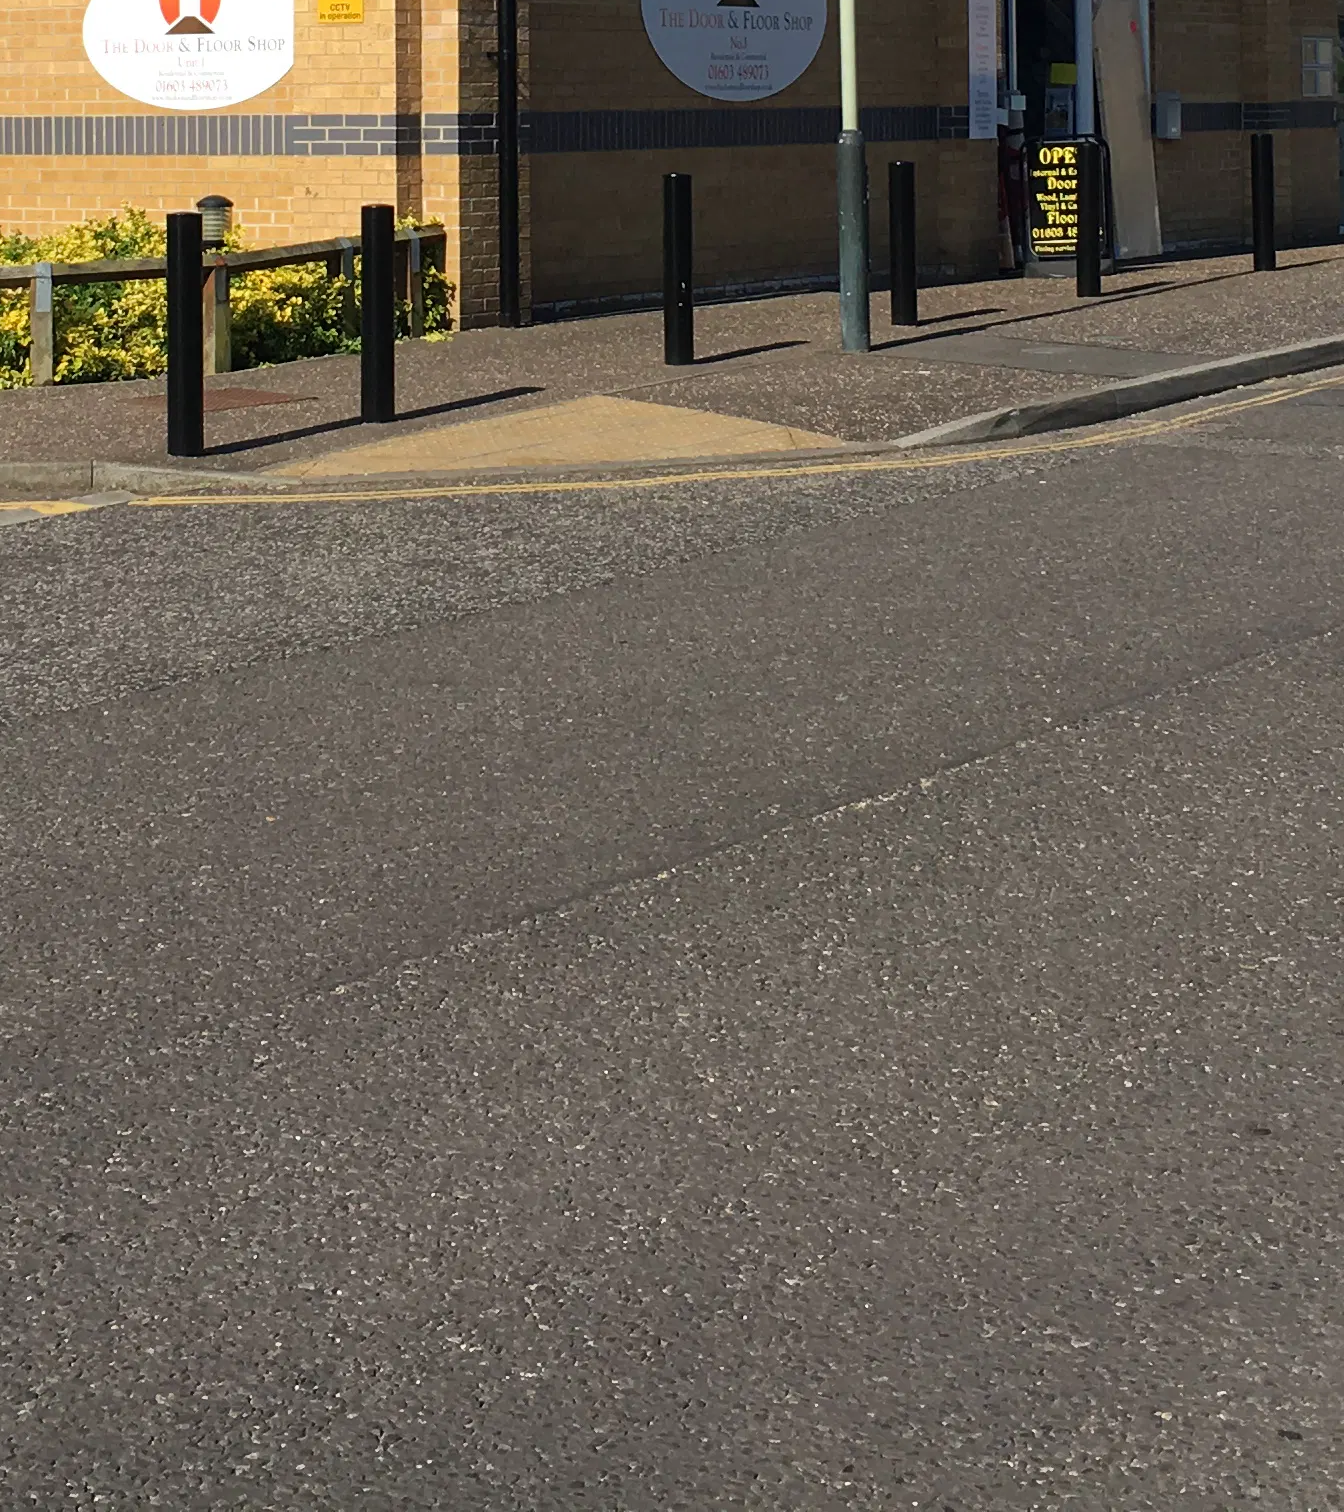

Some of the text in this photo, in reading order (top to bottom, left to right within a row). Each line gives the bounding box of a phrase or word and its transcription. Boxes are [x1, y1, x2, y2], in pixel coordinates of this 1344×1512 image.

[329, 3, 351, 11] CCTV
[328, 12, 361, 21] operation
[659, 8, 814, 31] THE DOOR & FLOOR SHOP
[104, 35, 286, 54] THE DOOR & FLOOR SHOP
[1039, 146, 1078, 164] OPE
[1047, 177, 1078, 190] Door
[1047, 211, 1078, 224] Floo
